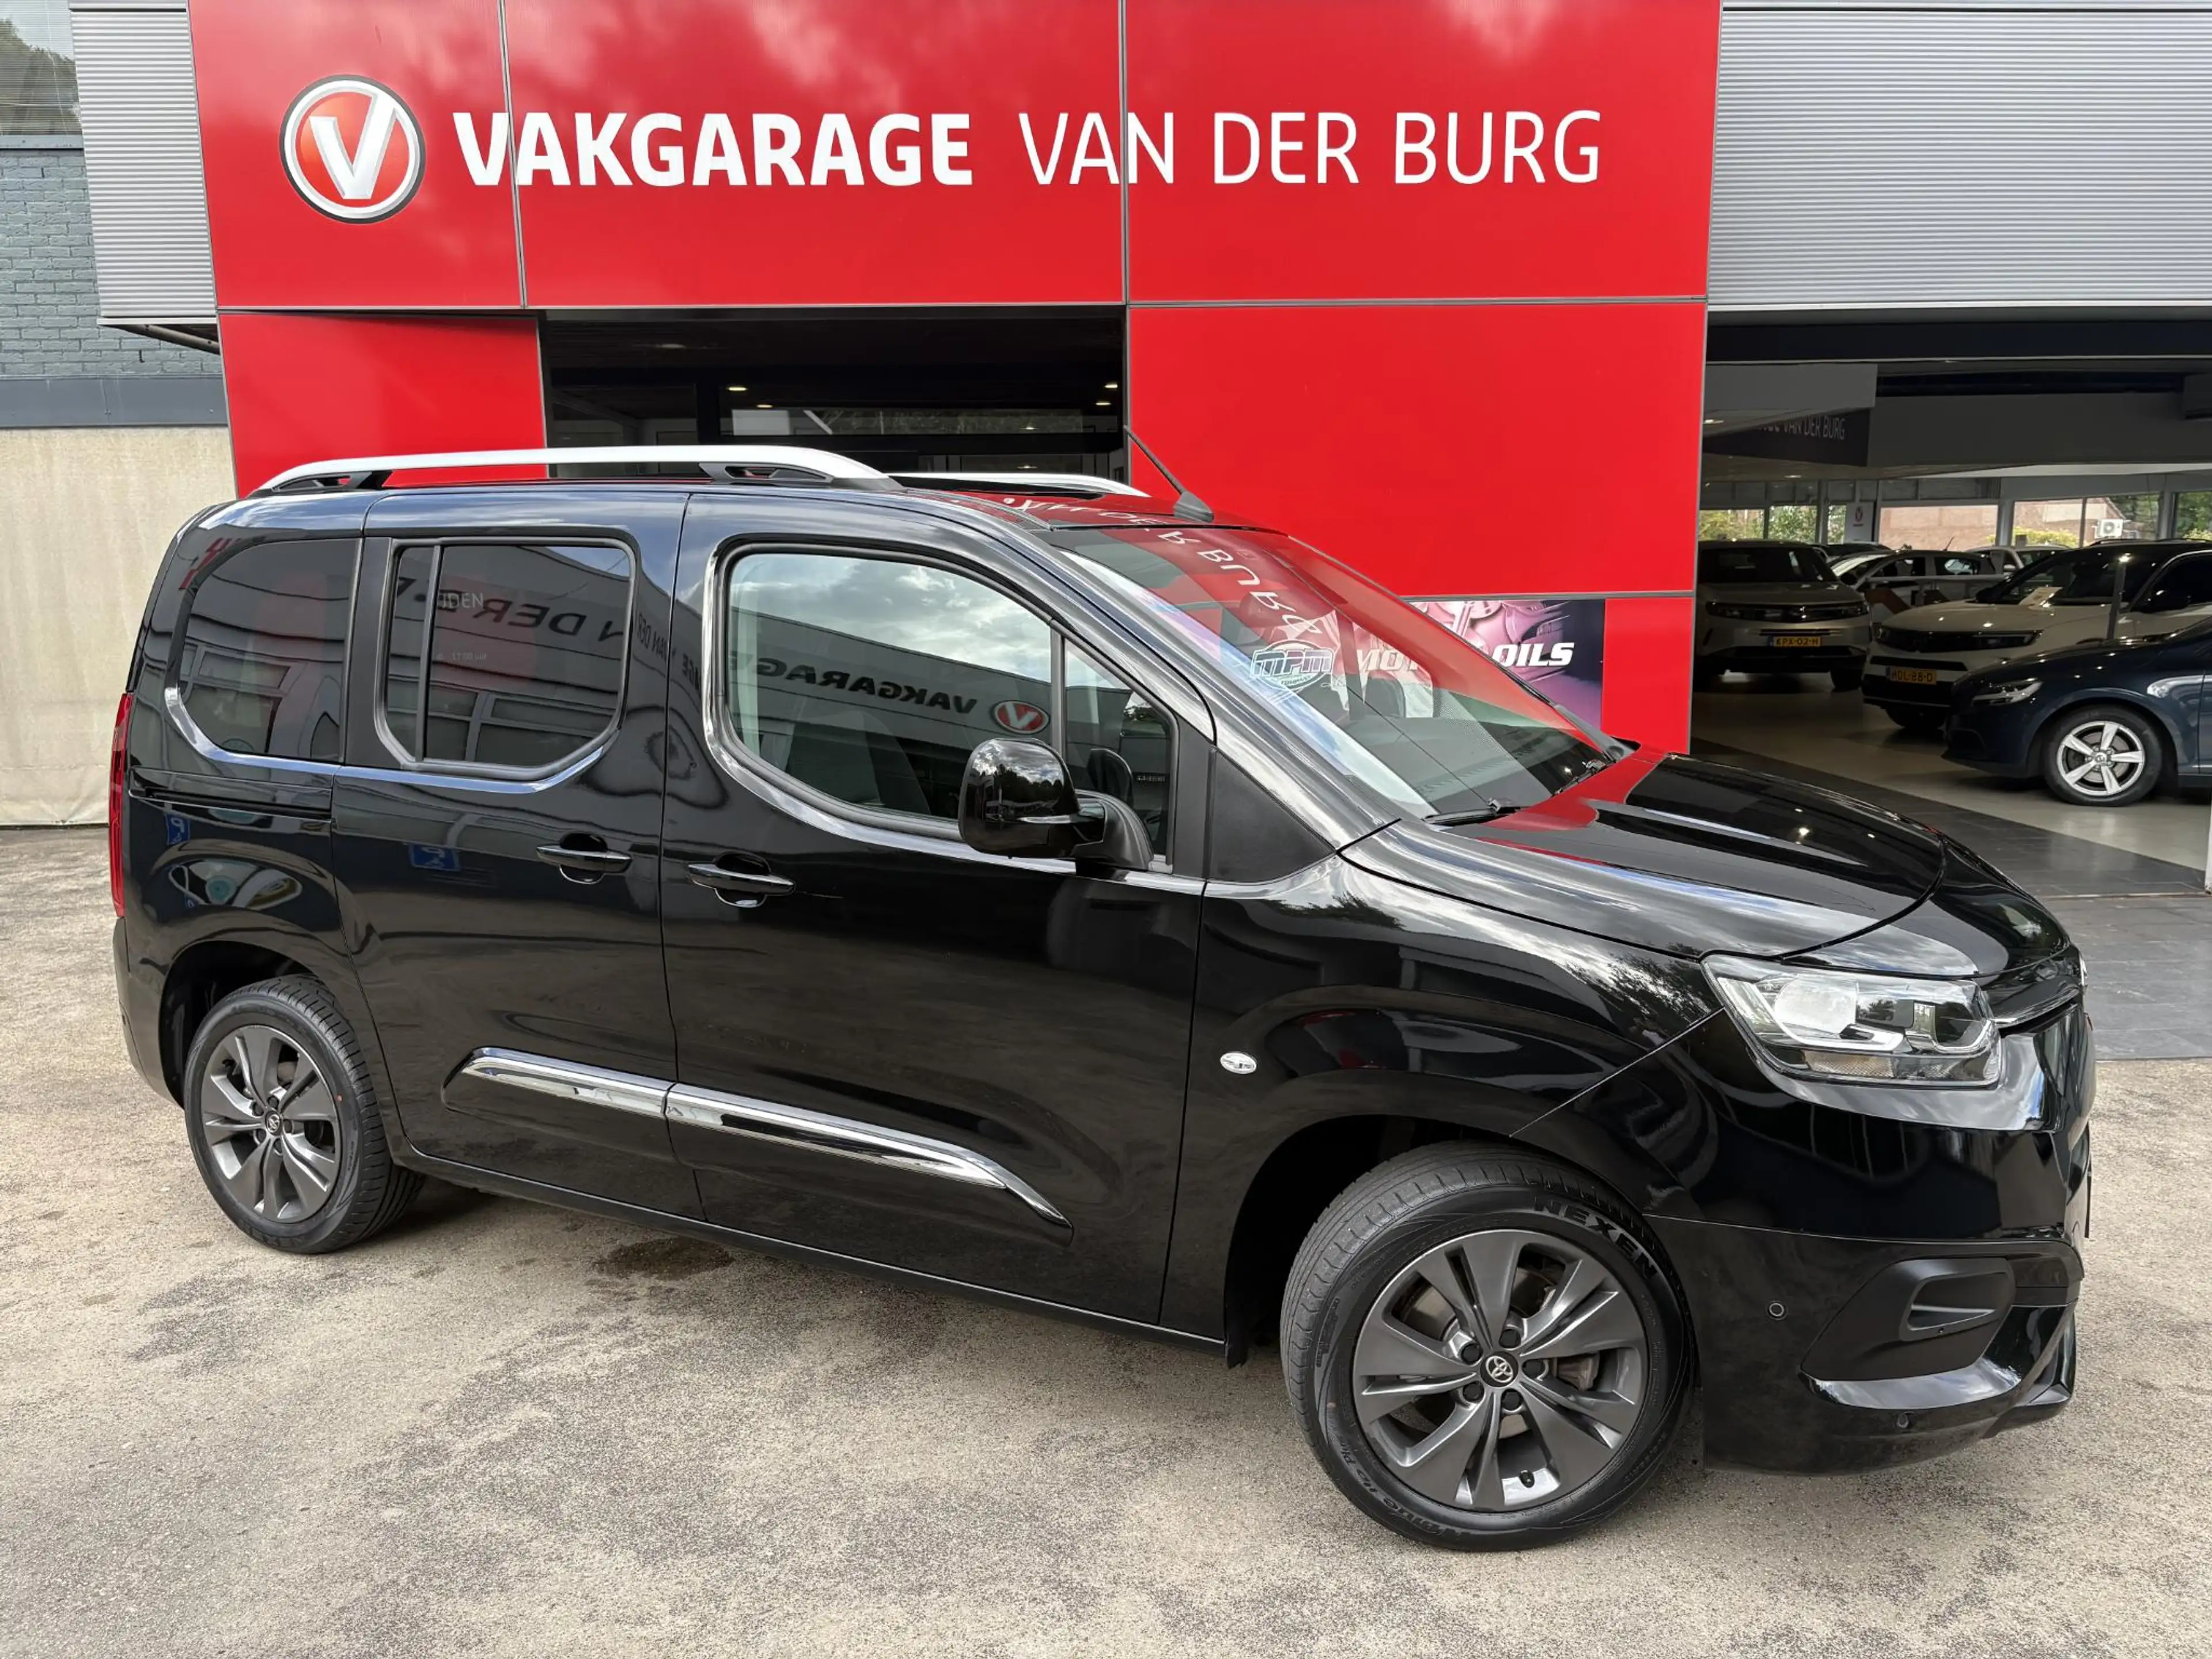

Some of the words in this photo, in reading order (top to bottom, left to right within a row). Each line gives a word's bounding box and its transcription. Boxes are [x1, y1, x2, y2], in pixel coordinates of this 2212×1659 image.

[453, 112, 972, 187] VAKGARAGE
[1018, 111, 1174, 185] VAN
[1213, 111, 1359, 184] DER
[1393, 110, 1601, 184] BURG
[1823, 415, 1846, 440] BURG
[1492, 642, 1575, 666] OILS
[1535, 1197, 1657, 1280] NEXEN
